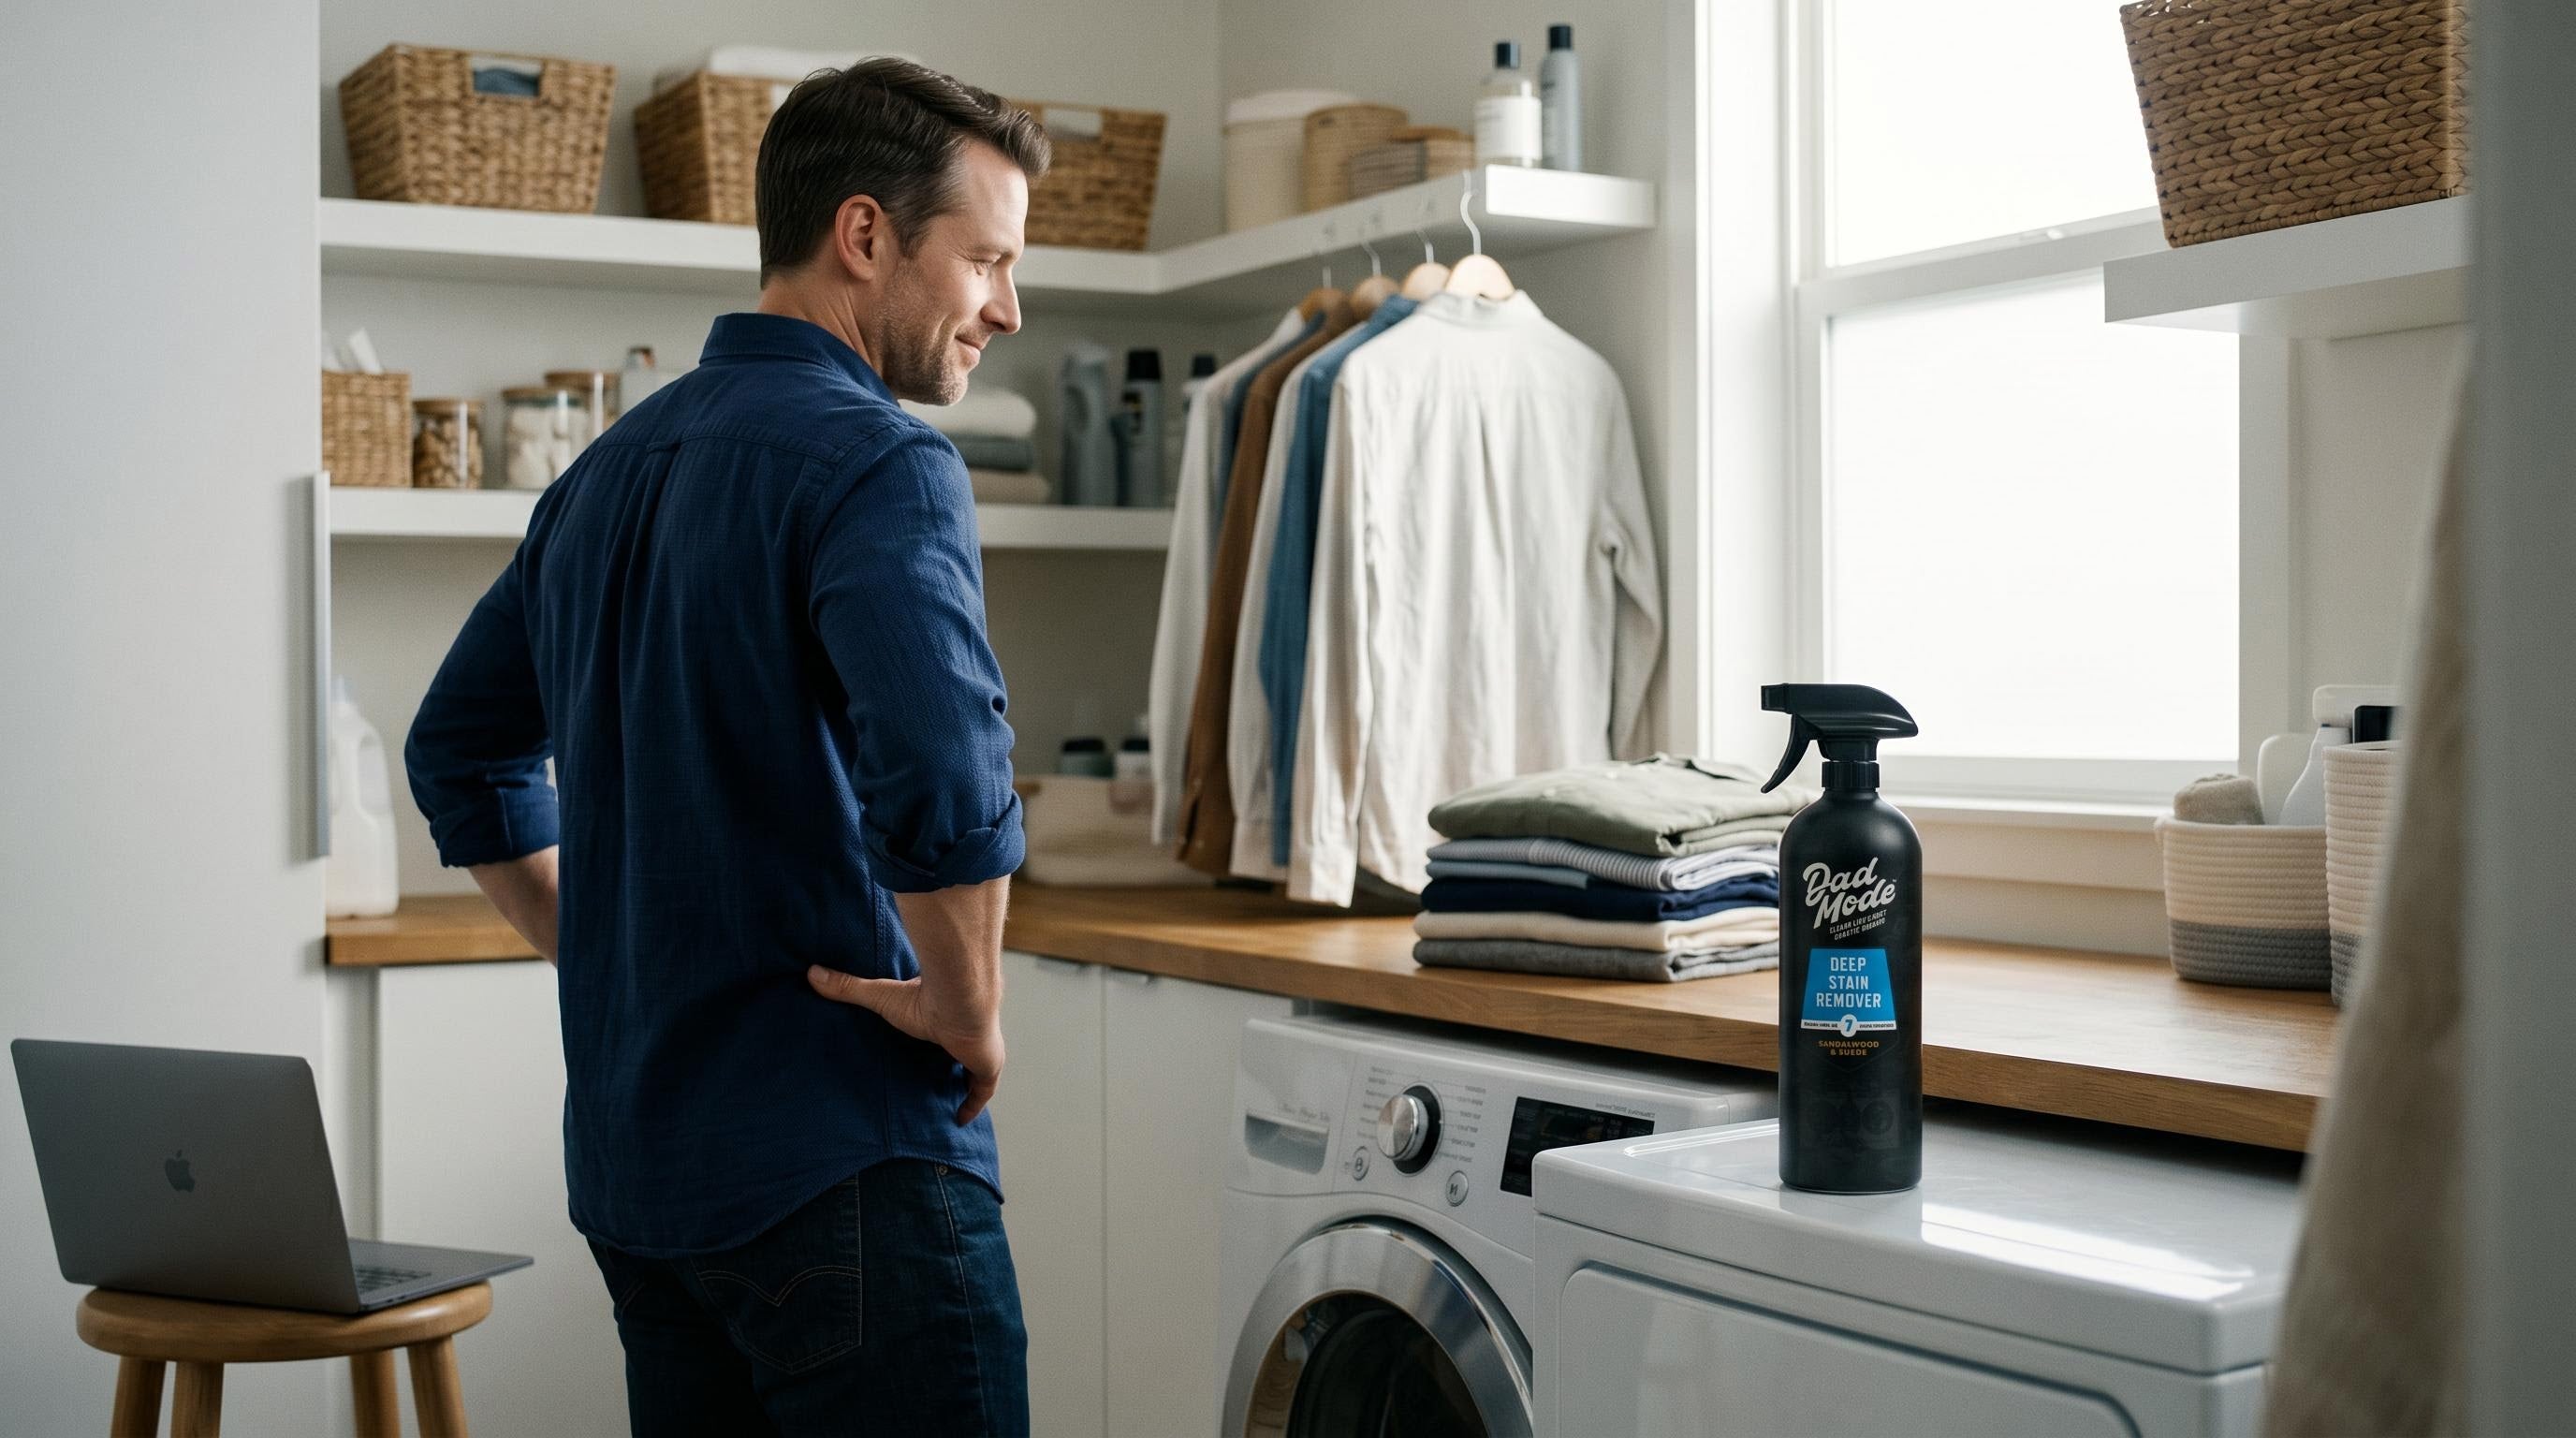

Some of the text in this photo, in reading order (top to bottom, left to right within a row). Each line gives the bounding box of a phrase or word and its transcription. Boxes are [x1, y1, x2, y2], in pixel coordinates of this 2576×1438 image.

[1803, 857, 1878, 906] Dad
[1813, 879, 1895, 929] Mode
[1830, 957, 1866, 972] DEEP
[1828, 976, 1869, 990] STAIN
[1816, 993, 1881, 1008] REMOVER
[1844, 1019, 1853, 1032] 7
